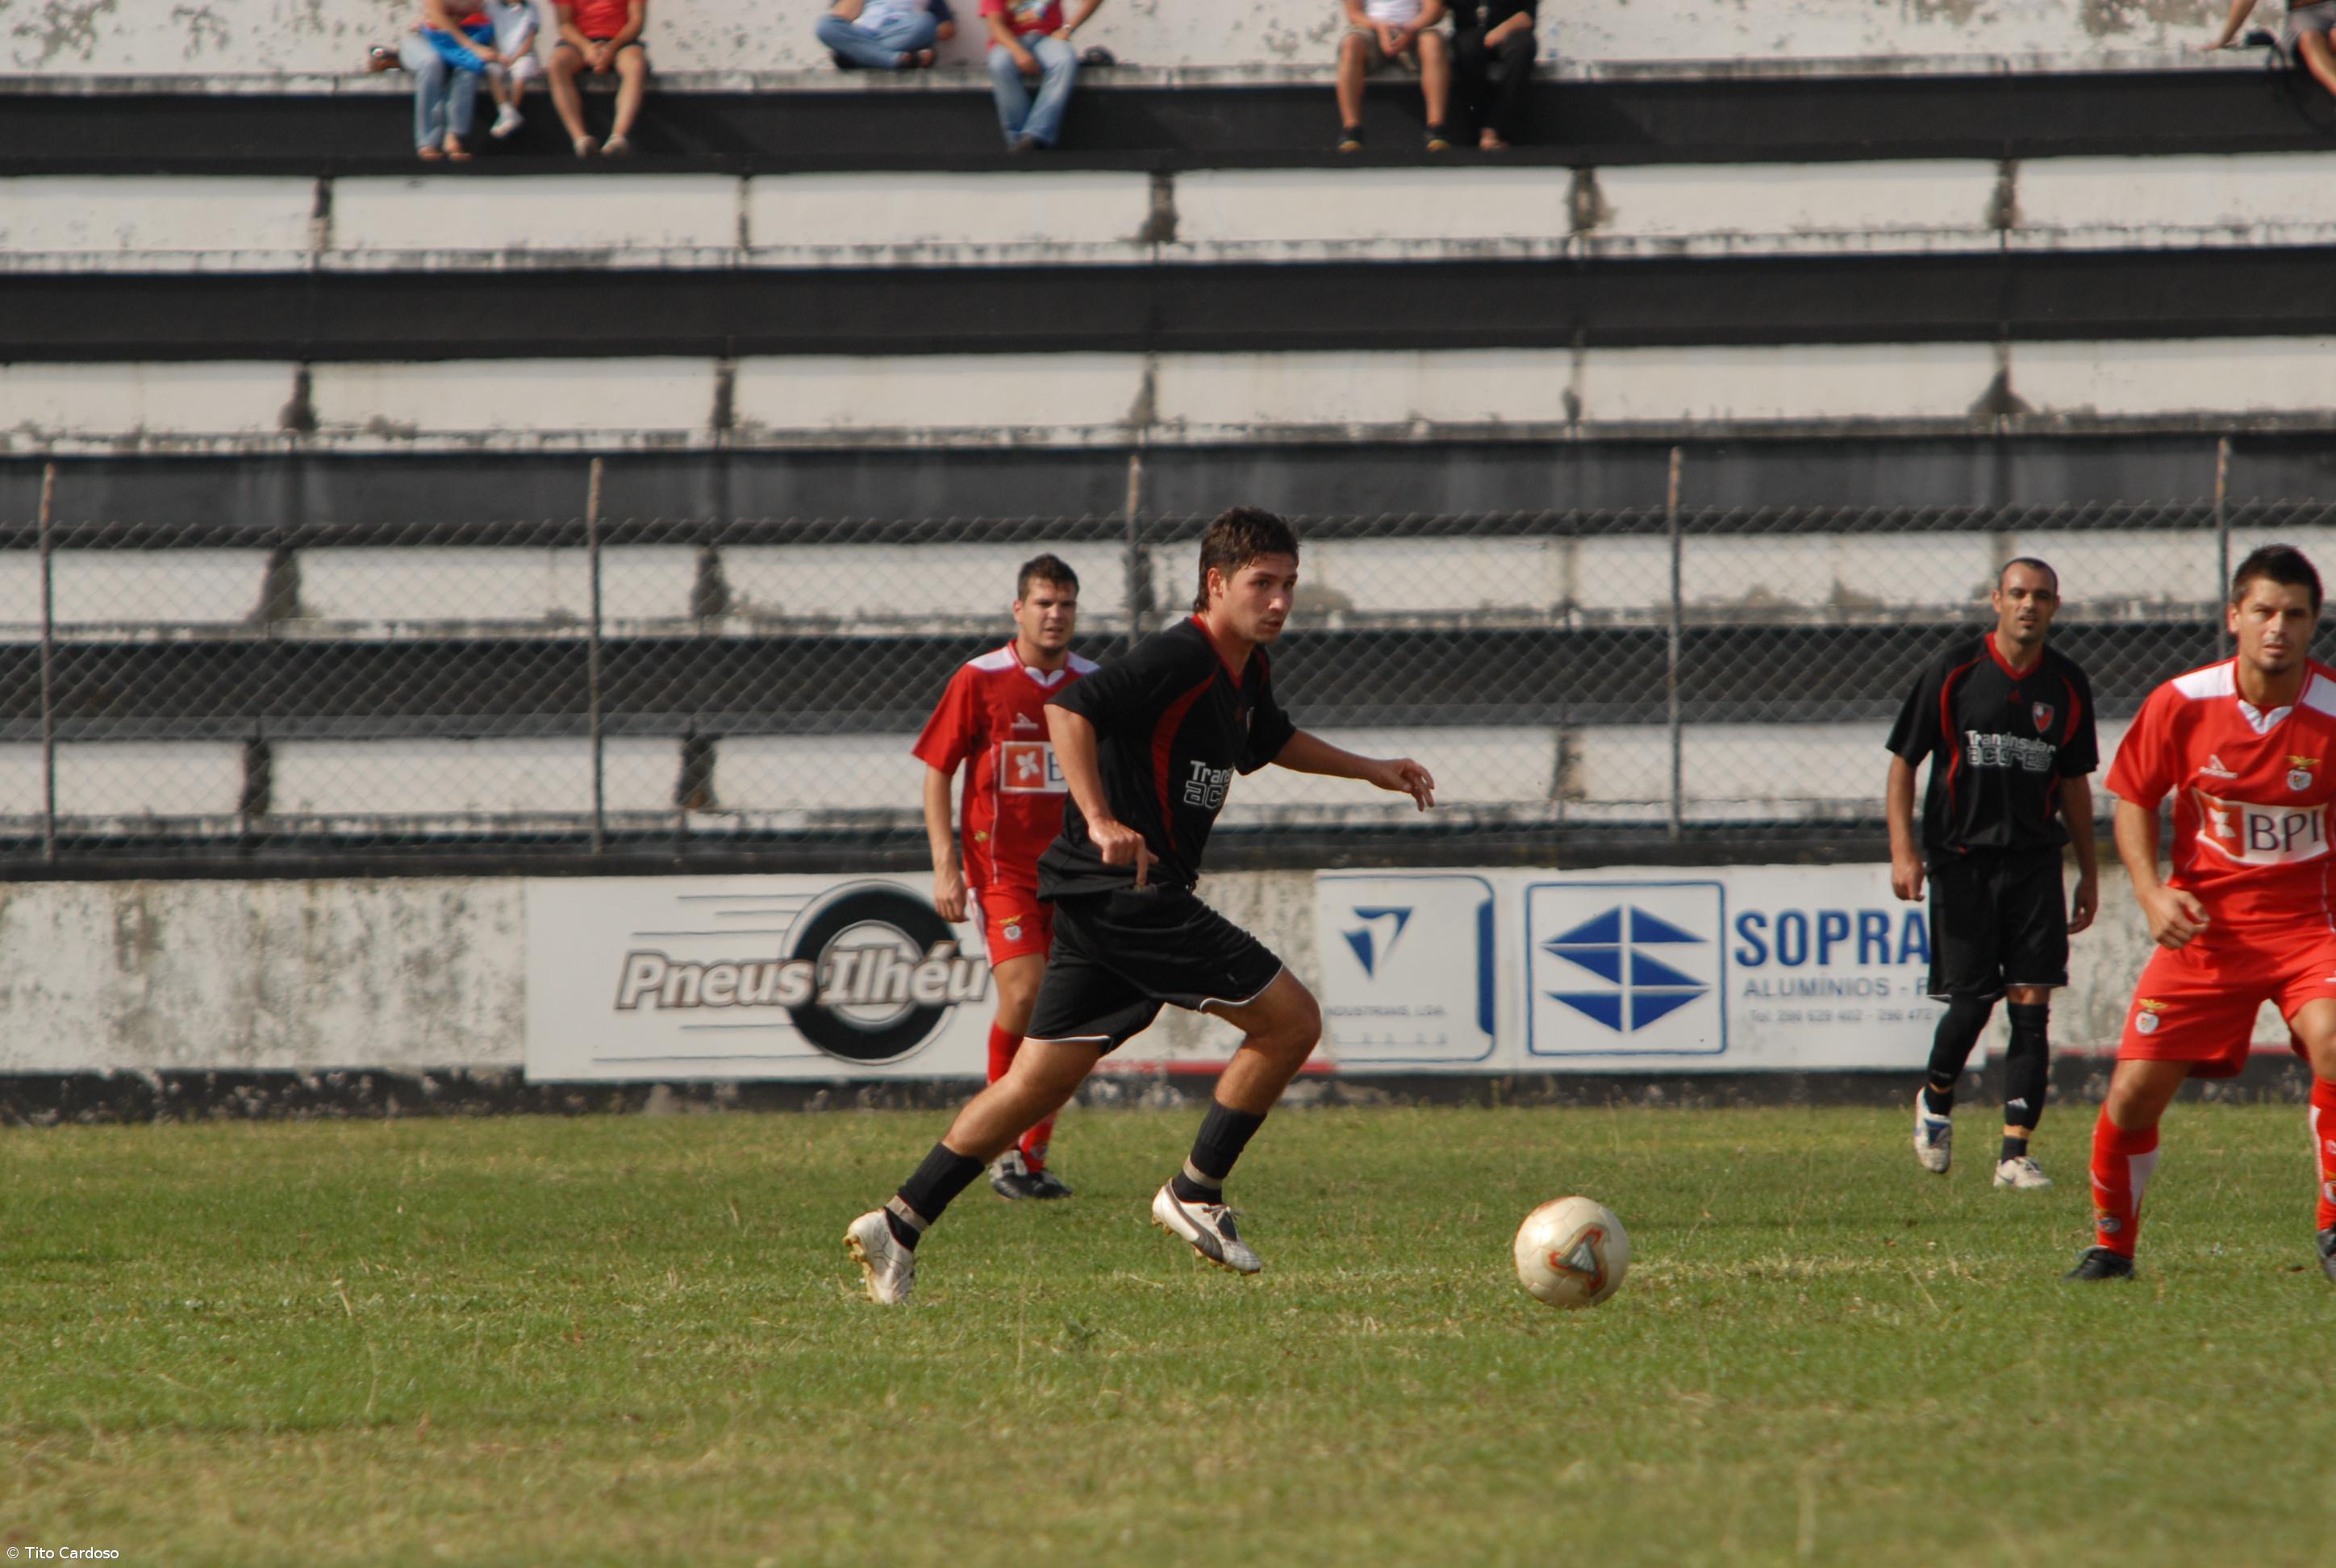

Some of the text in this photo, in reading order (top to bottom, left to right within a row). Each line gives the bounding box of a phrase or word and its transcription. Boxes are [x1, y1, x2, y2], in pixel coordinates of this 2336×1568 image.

[2249, 810, 2320, 853] BPI
[1735, 908, 1930, 966] SOPRA
[613, 940, 991, 1009] Pneus Ilhéu
